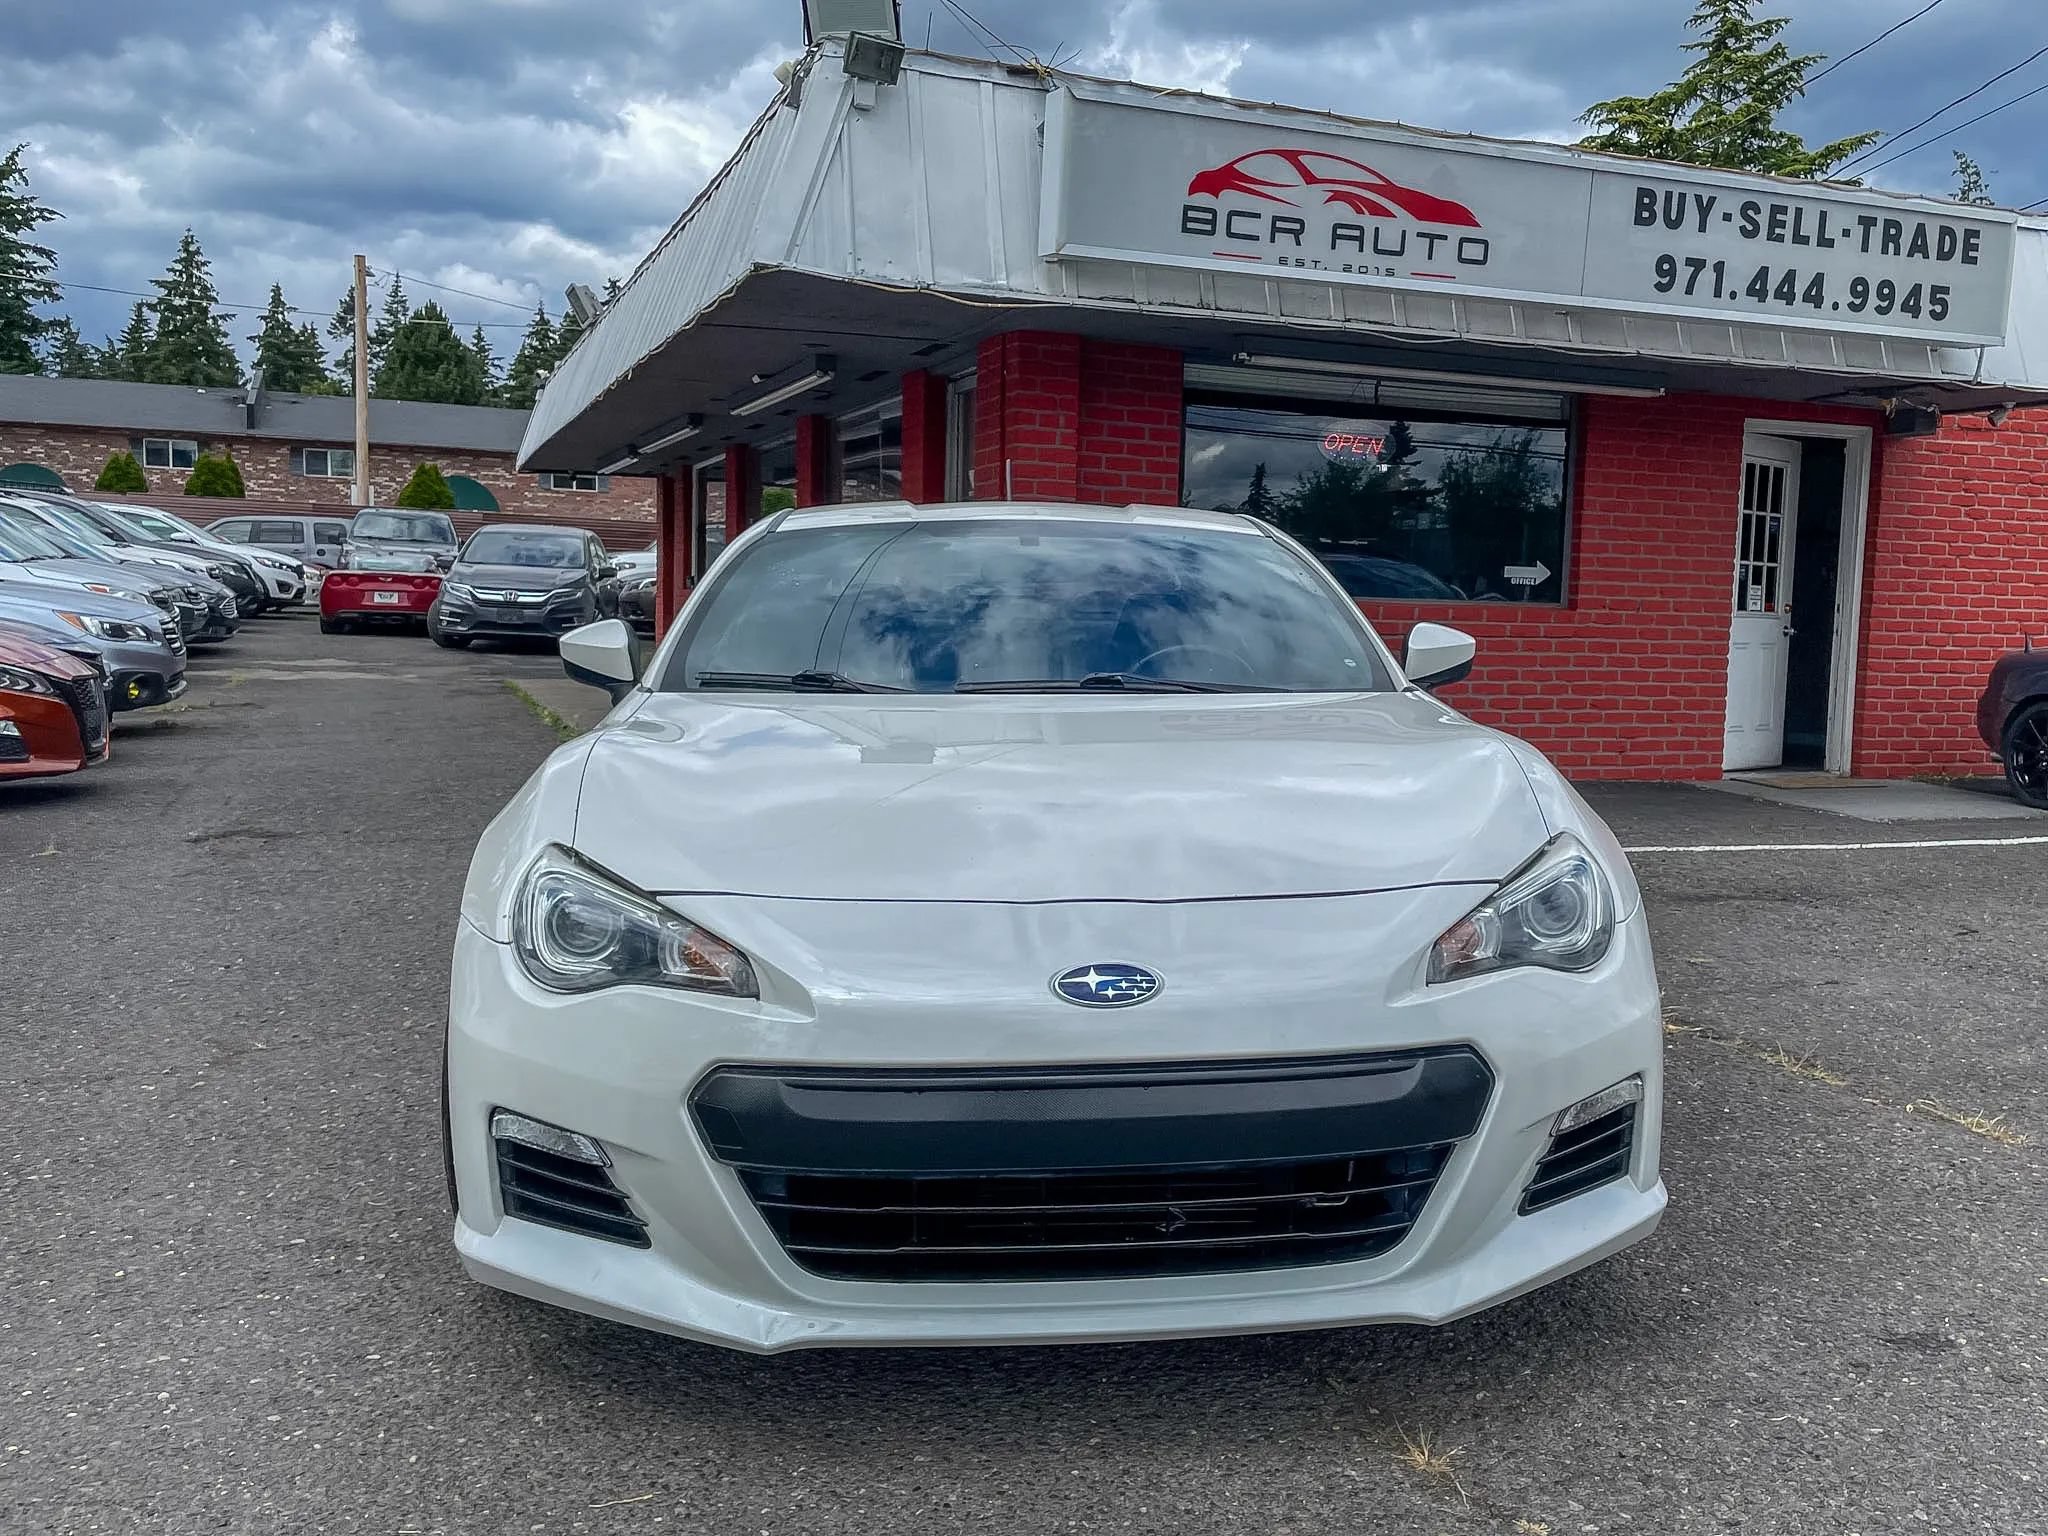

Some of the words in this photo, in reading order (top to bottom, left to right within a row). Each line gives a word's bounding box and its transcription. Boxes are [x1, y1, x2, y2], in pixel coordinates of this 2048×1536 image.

[1181, 204, 1305, 247] BCR
[1330, 222, 1489, 266] AUTO
[1278, 256, 1328, 271] EST.
[1342, 263, 1396, 277] 2015
[1653, 253, 1951, 321] 971.444.9945
[1325, 433, 1385, 456] OPEN
[1510, 577, 1537, 586] OFFICE
